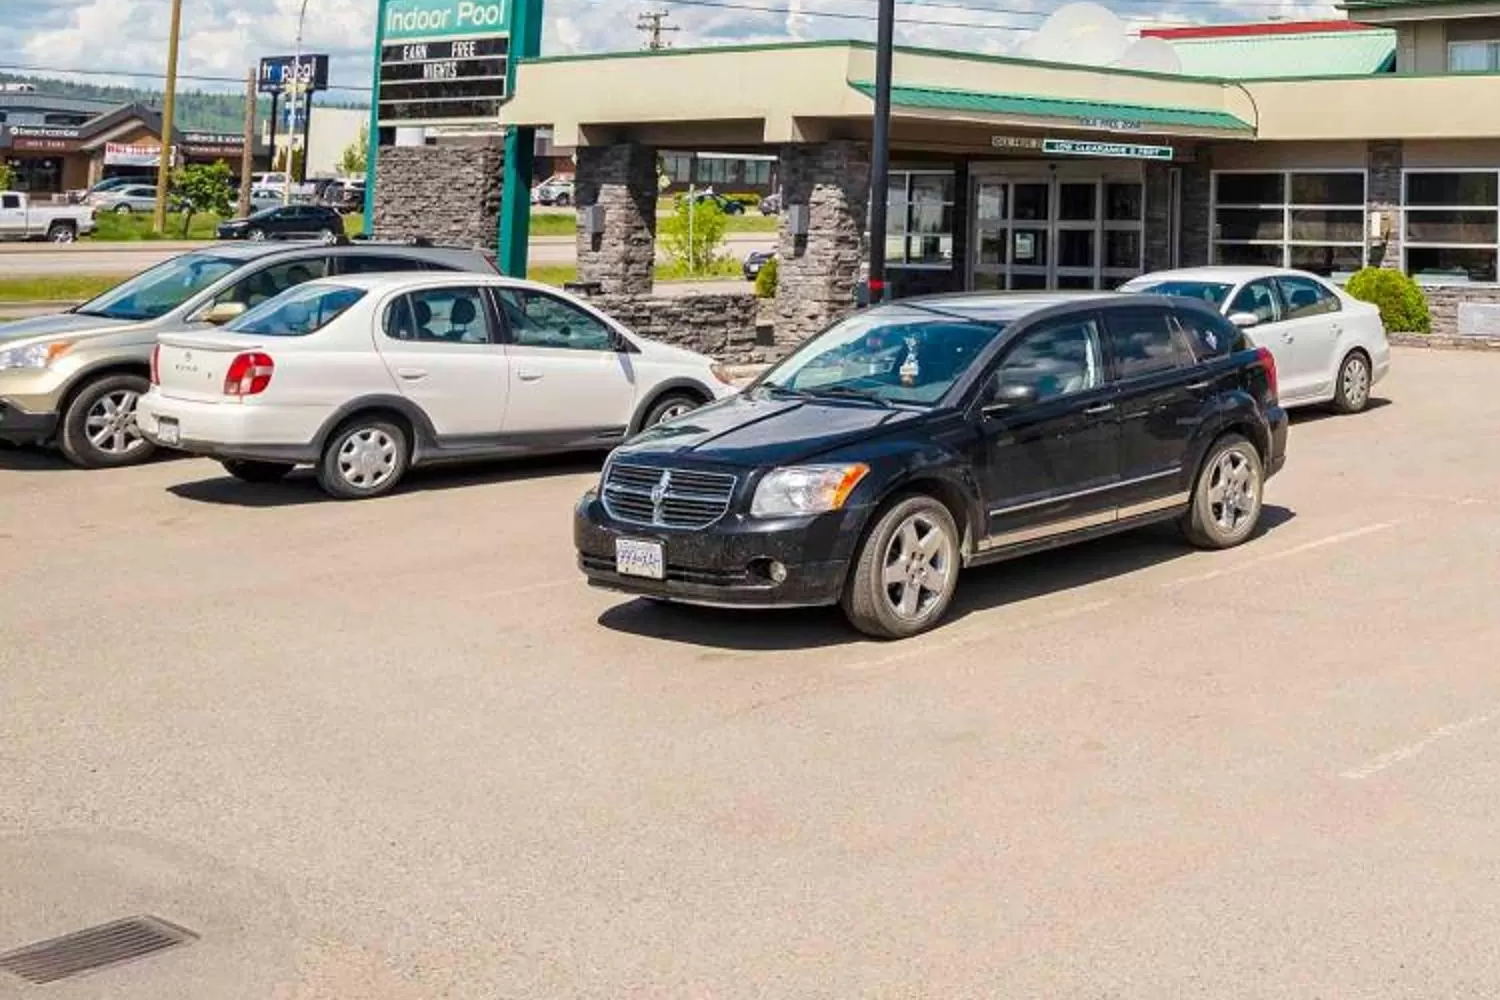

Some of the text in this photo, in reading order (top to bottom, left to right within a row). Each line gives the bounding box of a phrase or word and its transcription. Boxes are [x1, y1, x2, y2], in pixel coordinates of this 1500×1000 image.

[386, 6, 451, 32] Indoor
[403, 41, 477, 60] EARN FREE
